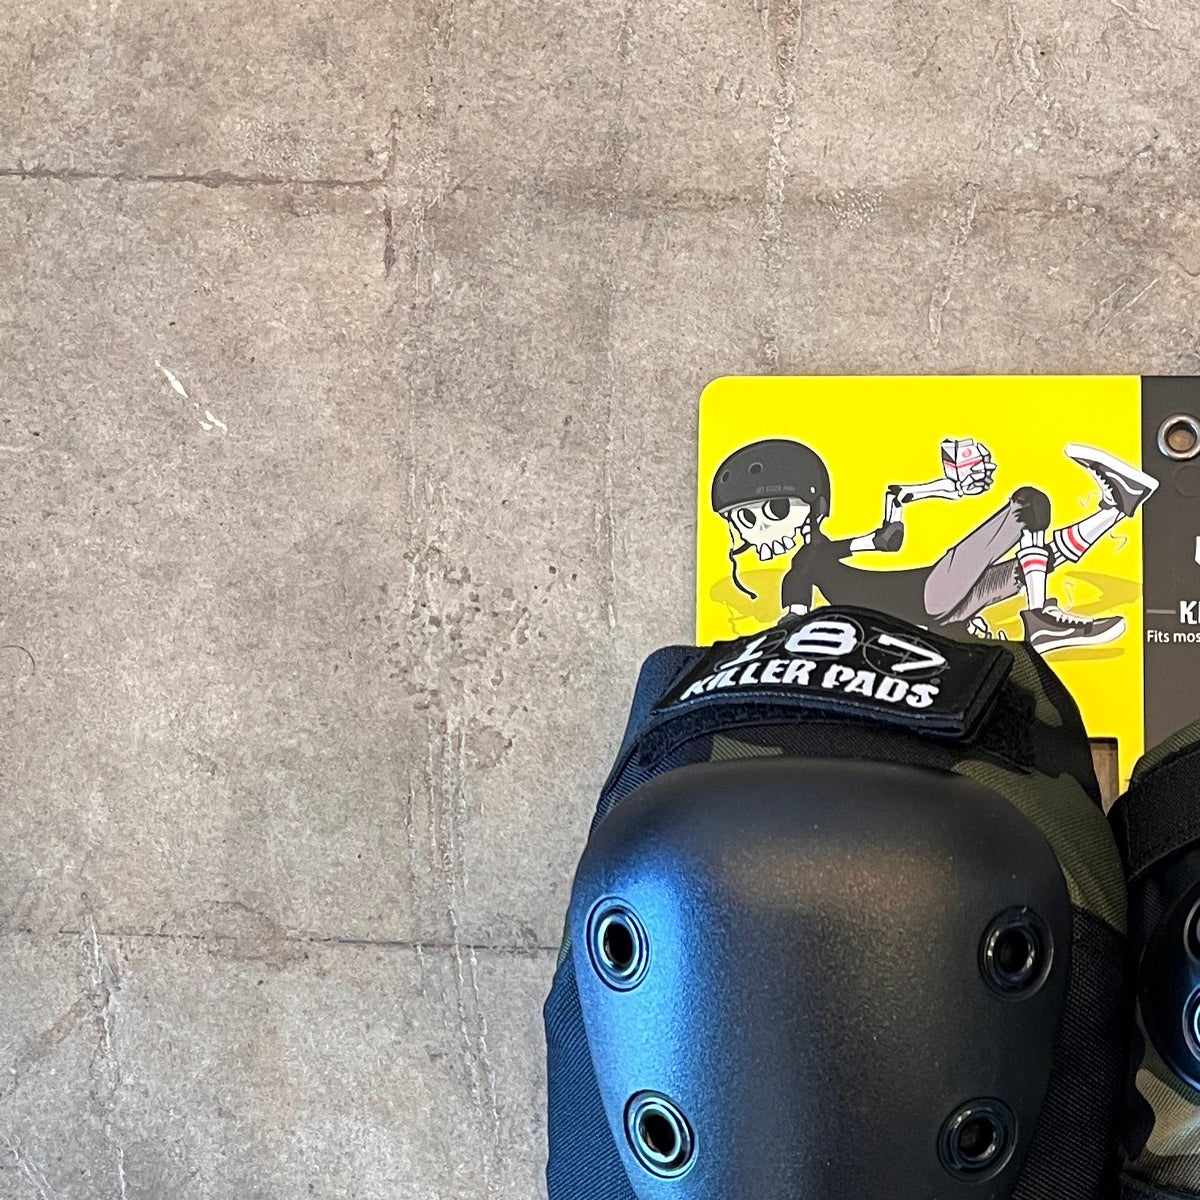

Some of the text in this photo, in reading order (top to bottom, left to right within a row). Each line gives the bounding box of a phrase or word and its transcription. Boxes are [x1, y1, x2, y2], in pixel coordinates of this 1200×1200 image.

[720, 621, 946, 672] 187
[1146, 630, 1170, 643] Fits
[680, 659, 939, 708] KILLER PADS
